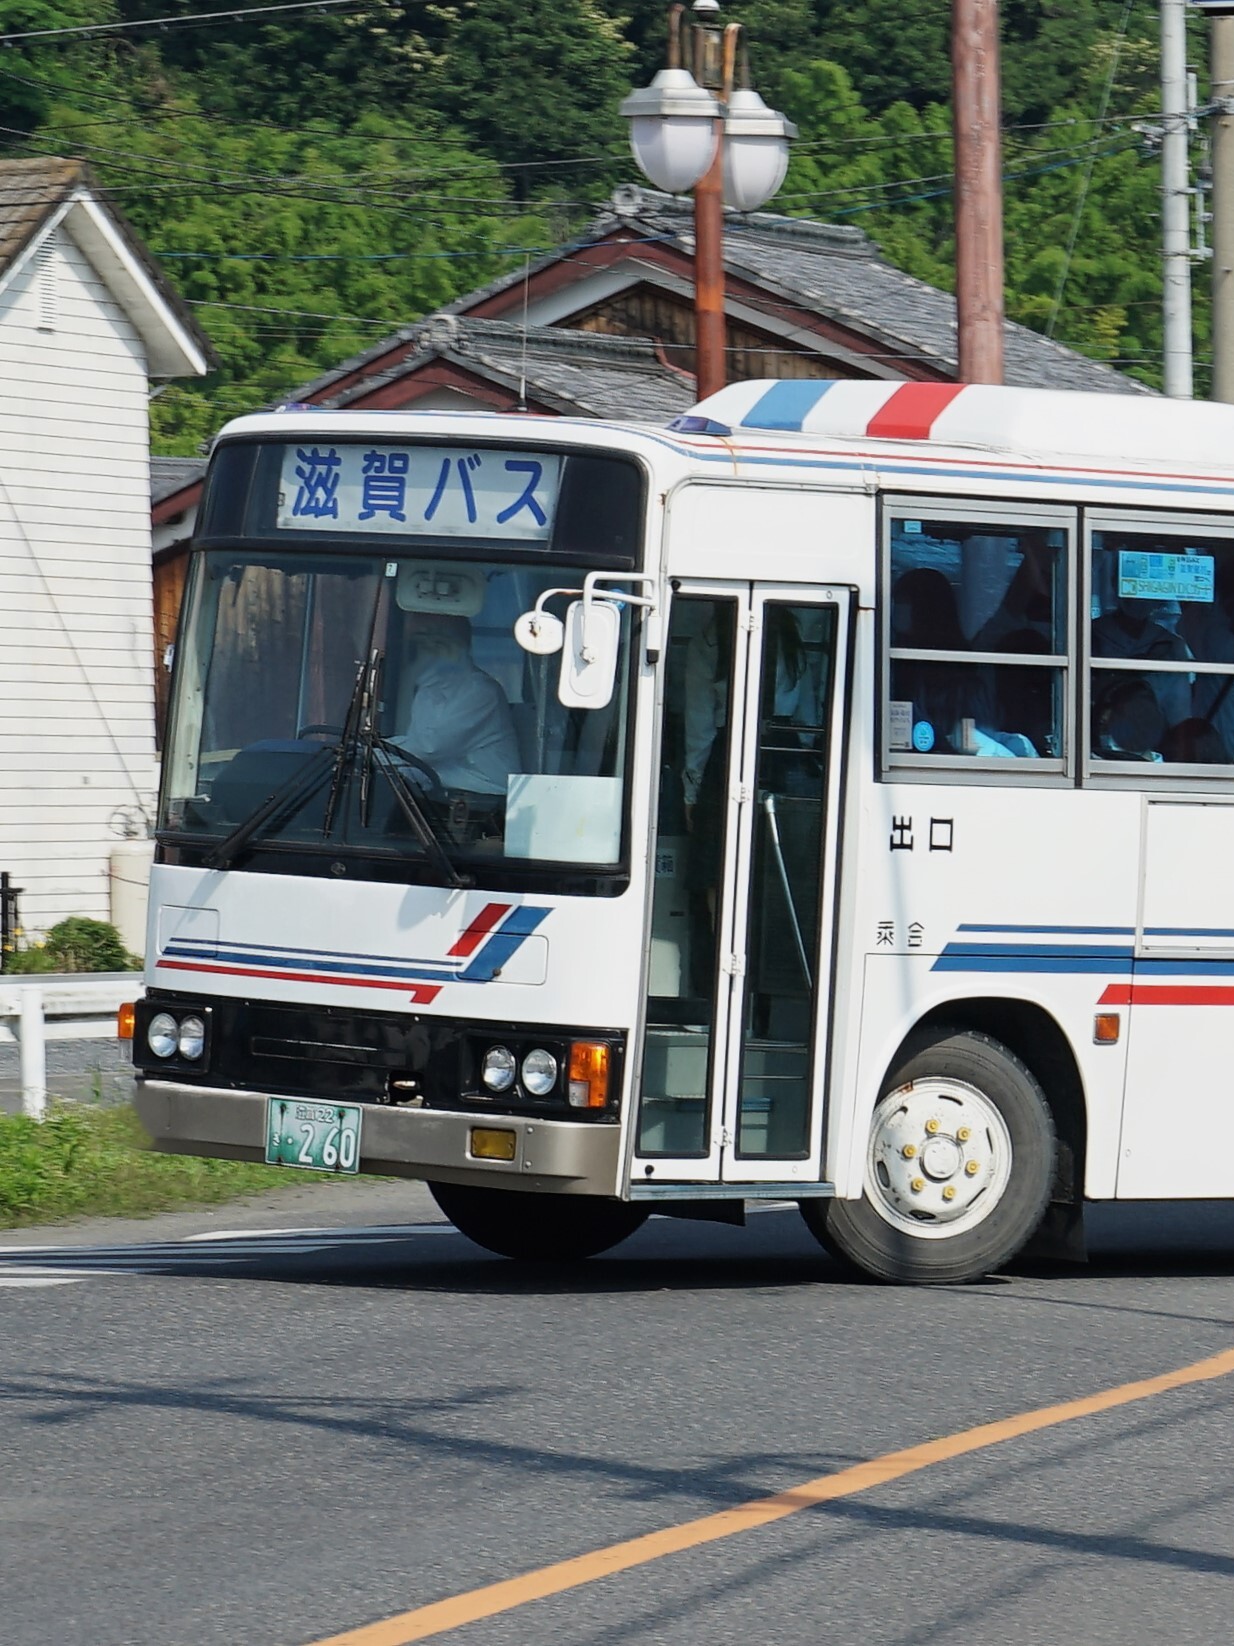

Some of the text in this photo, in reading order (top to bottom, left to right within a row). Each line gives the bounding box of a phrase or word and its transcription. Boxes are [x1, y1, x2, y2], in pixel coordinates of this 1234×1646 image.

[291, 447, 548, 527] 滋賀バス
[889, 815, 954, 853] 出口
[876, 920, 925, 948] 乗合
